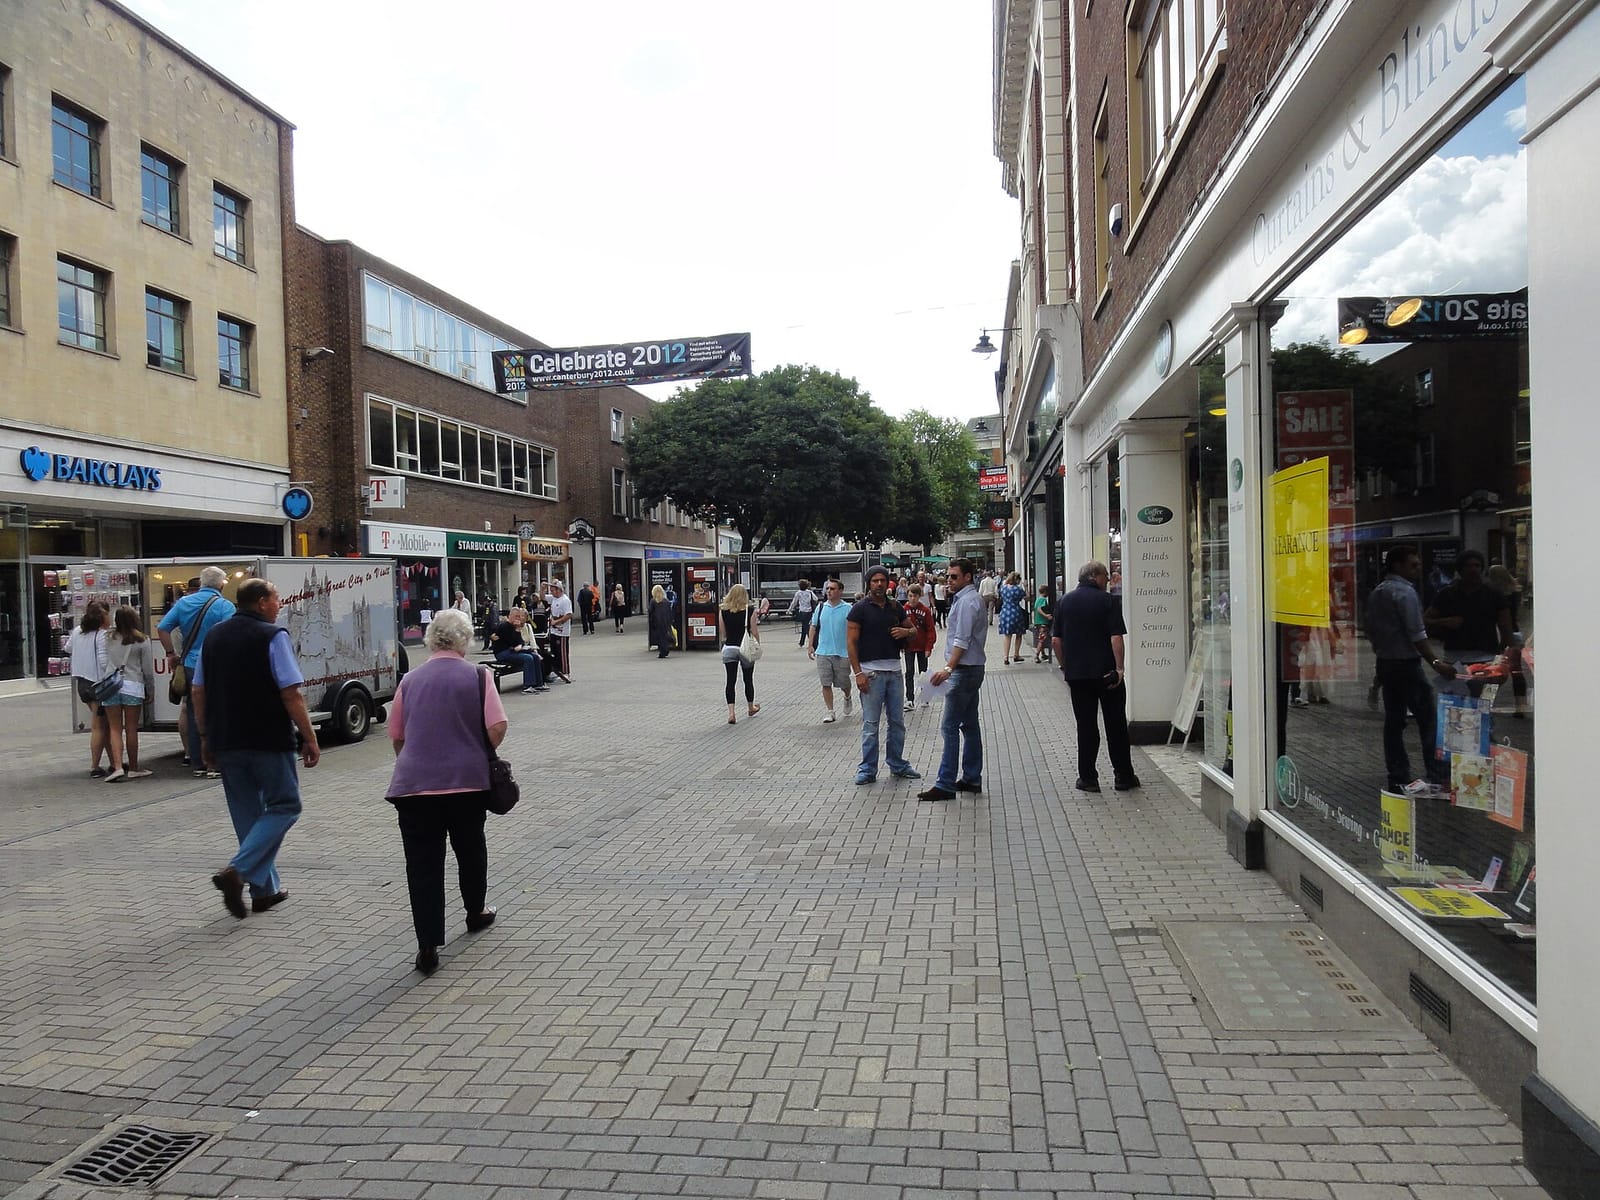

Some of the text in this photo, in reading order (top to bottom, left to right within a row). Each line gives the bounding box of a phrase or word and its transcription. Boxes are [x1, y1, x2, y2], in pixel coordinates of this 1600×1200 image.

[1253, 151, 1335, 267] Curtains
[1342, 108, 1371, 172] &
[530, 343, 687, 374] Celebrate 2012
[532, 368, 635, 383] www.canterbury2012.co.uk
[506, 382, 526, 391] 2012
[1285, 406, 1344, 434] SALE
[53, 454, 162, 491] BARCLAYS
[370, 480, 387, 502] T
[1136, 535, 1173, 543] Curtains
[1273, 531, 1319, 556] LEARANCE
[457, 540, 517, 553] STARBUCKS COFFEE
[1142, 552, 1169, 560] Blinds
[1142, 569, 1170, 578] Tracks
[325, 580, 346, 596] Great
[348, 573, 363, 590] City
[365, 573, 372, 581] to
[373, 567, 390, 578] Visit
[1136, 587, 1177, 597] Handbags
[1146, 605, 1168, 614] Gifts
[1142, 622, 1173, 632] Sewing
[1141, 640, 1176, 649] Knitting
[1145, 657, 1172, 667] Crafts
[1304, 786, 1329, 819] Knitting
[1337, 806, 1363, 842] Sewing
